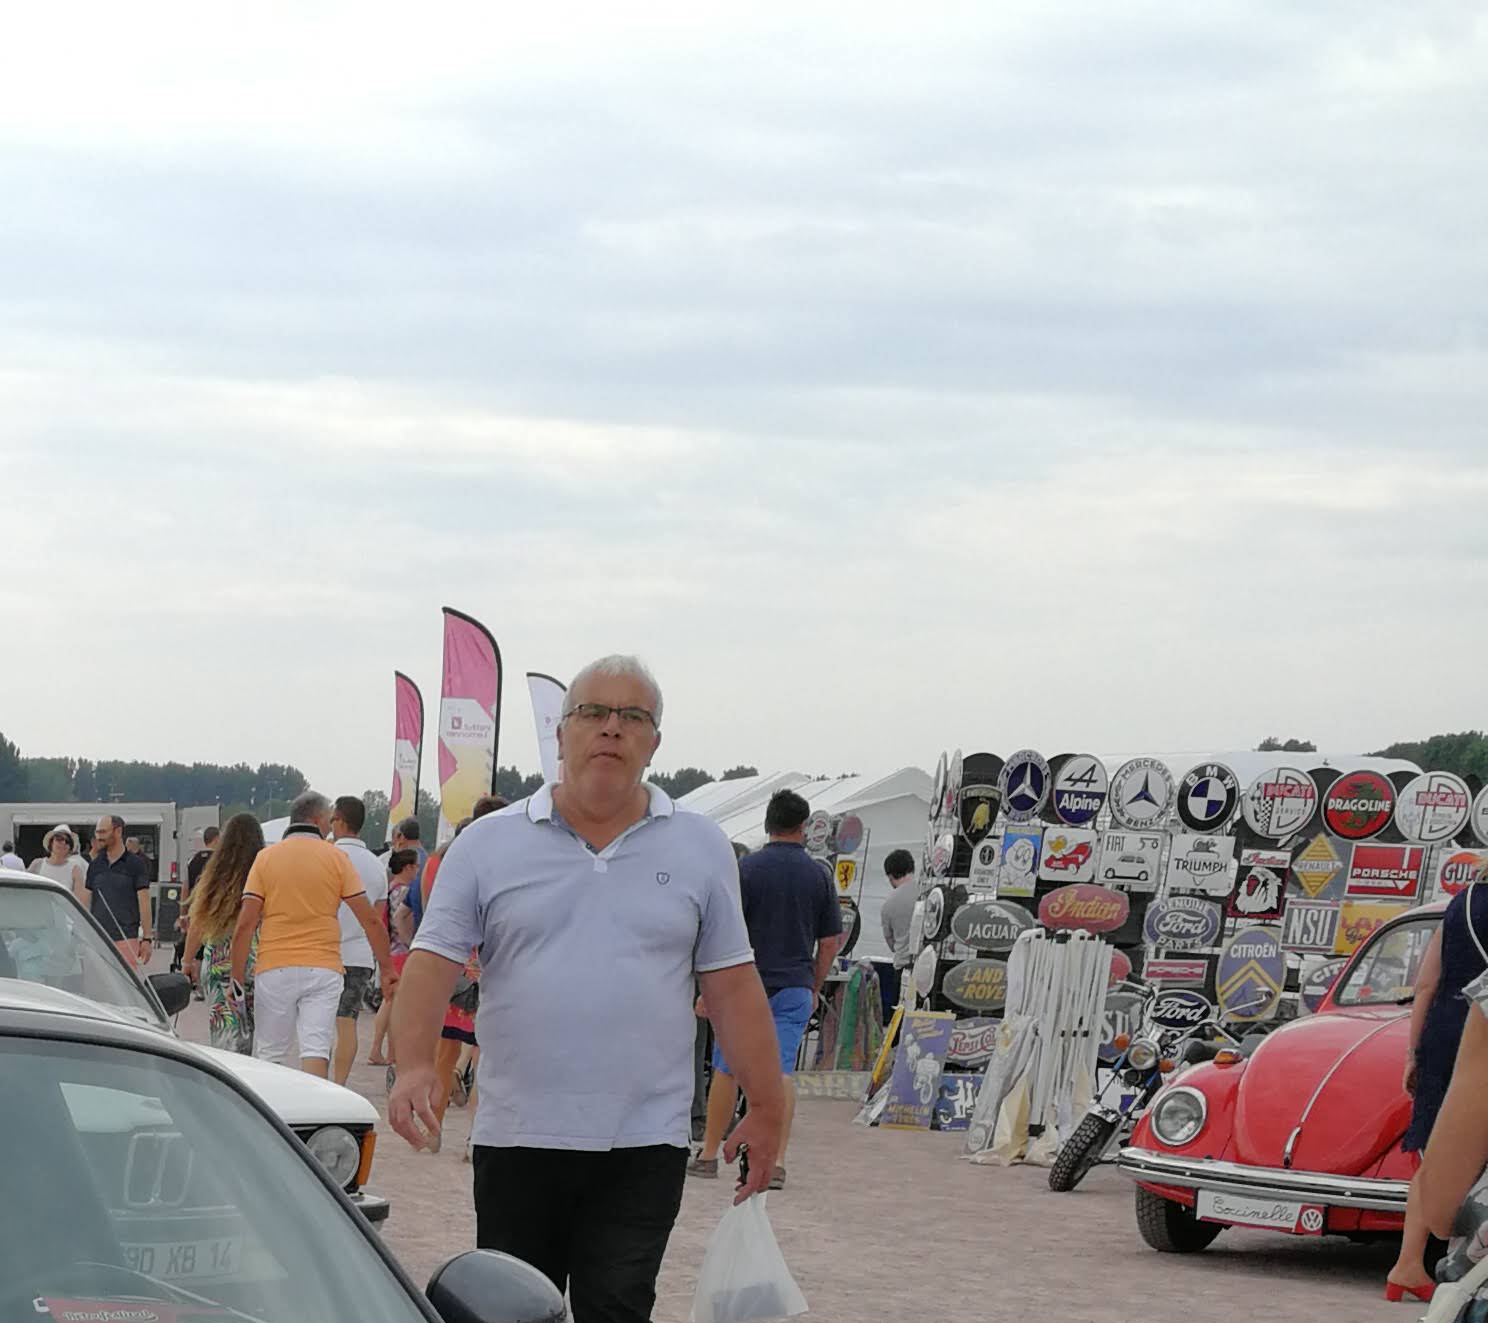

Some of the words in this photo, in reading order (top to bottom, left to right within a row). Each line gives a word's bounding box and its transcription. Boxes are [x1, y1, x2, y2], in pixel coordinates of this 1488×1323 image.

[1121, 759, 1172, 782] MERCEDES
[1185, 764, 1236, 791] BMW
[1265, 783, 1313, 798] DUCATI
[1059, 793, 1101, 812] Alpine
[1328, 799, 1392, 812] DRAGOLINE
[1417, 792, 1467, 807] DUCATI
[1106, 835, 1125, 851] FIAT
[1174, 857, 1228, 874] TRIUMPH
[1352, 868, 1418, 880] PORSCHE
[1049, 889, 1121, 920] Indian
[966, 922, 1020, 940] JAGUAR
[1158, 914, 1207, 934] Ford
[1289, 908, 1331, 946] NSU
[1230, 942, 1276, 959] CITROËN
[963, 967, 1005, 983] LAND
[964, 984, 1006, 1000] ROVE
[1152, 997, 1208, 1021] Ford
